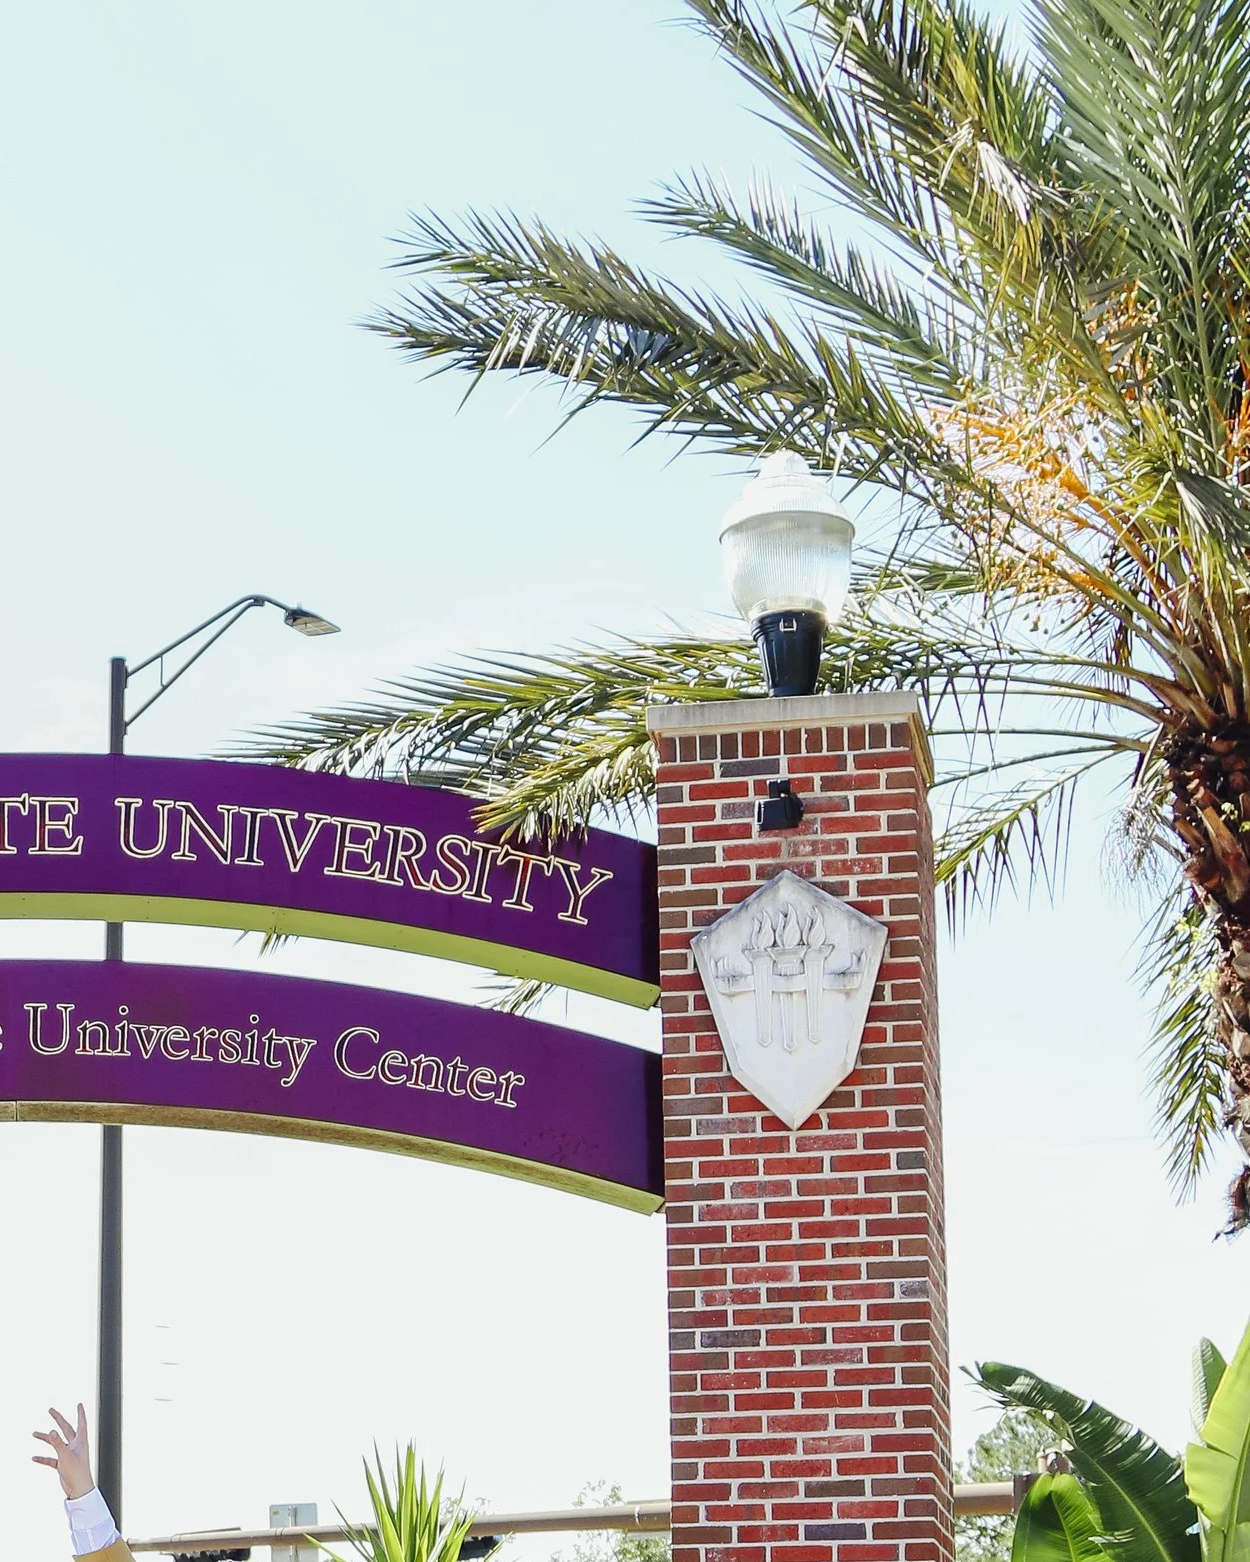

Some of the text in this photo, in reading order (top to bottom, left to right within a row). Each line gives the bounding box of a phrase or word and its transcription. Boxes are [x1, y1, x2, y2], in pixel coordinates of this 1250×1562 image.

[115, 797, 613, 925] UNIVERSITY
[23, 1003, 316, 1088] University
[334, 1026, 526, 1109] Center
